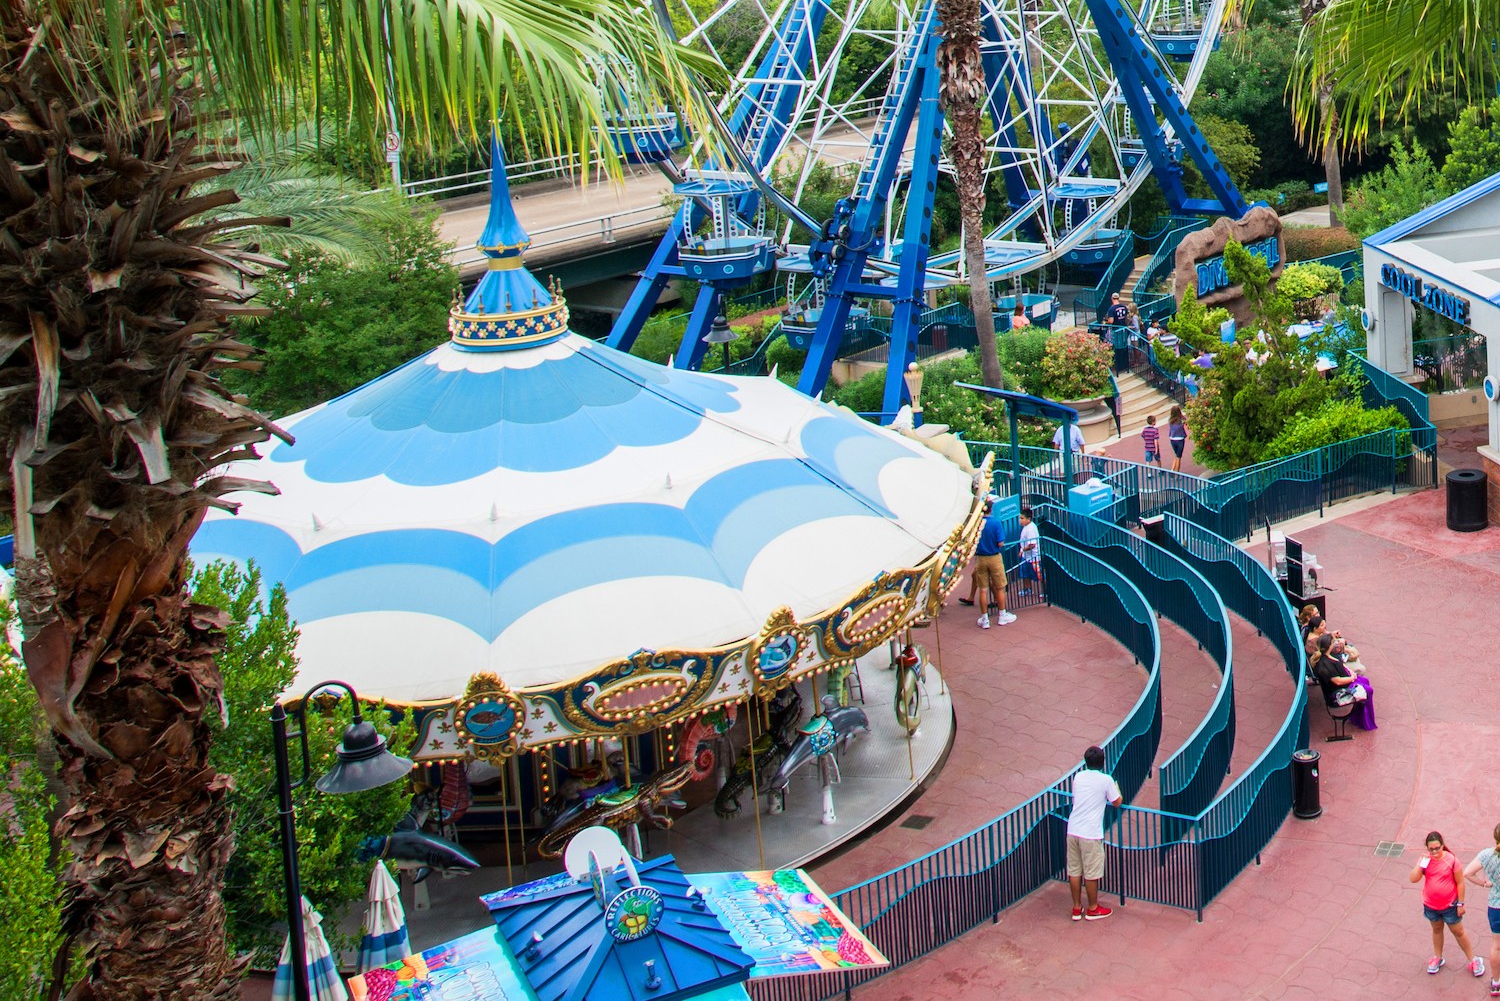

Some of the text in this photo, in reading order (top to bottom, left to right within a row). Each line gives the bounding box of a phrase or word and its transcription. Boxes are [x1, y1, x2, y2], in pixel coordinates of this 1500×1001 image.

[1381, 263, 1468, 326] COOL ZONE
[607, 887, 663, 920] REFLECTIONS
[611, 916, 661, 942] CARICATURES
